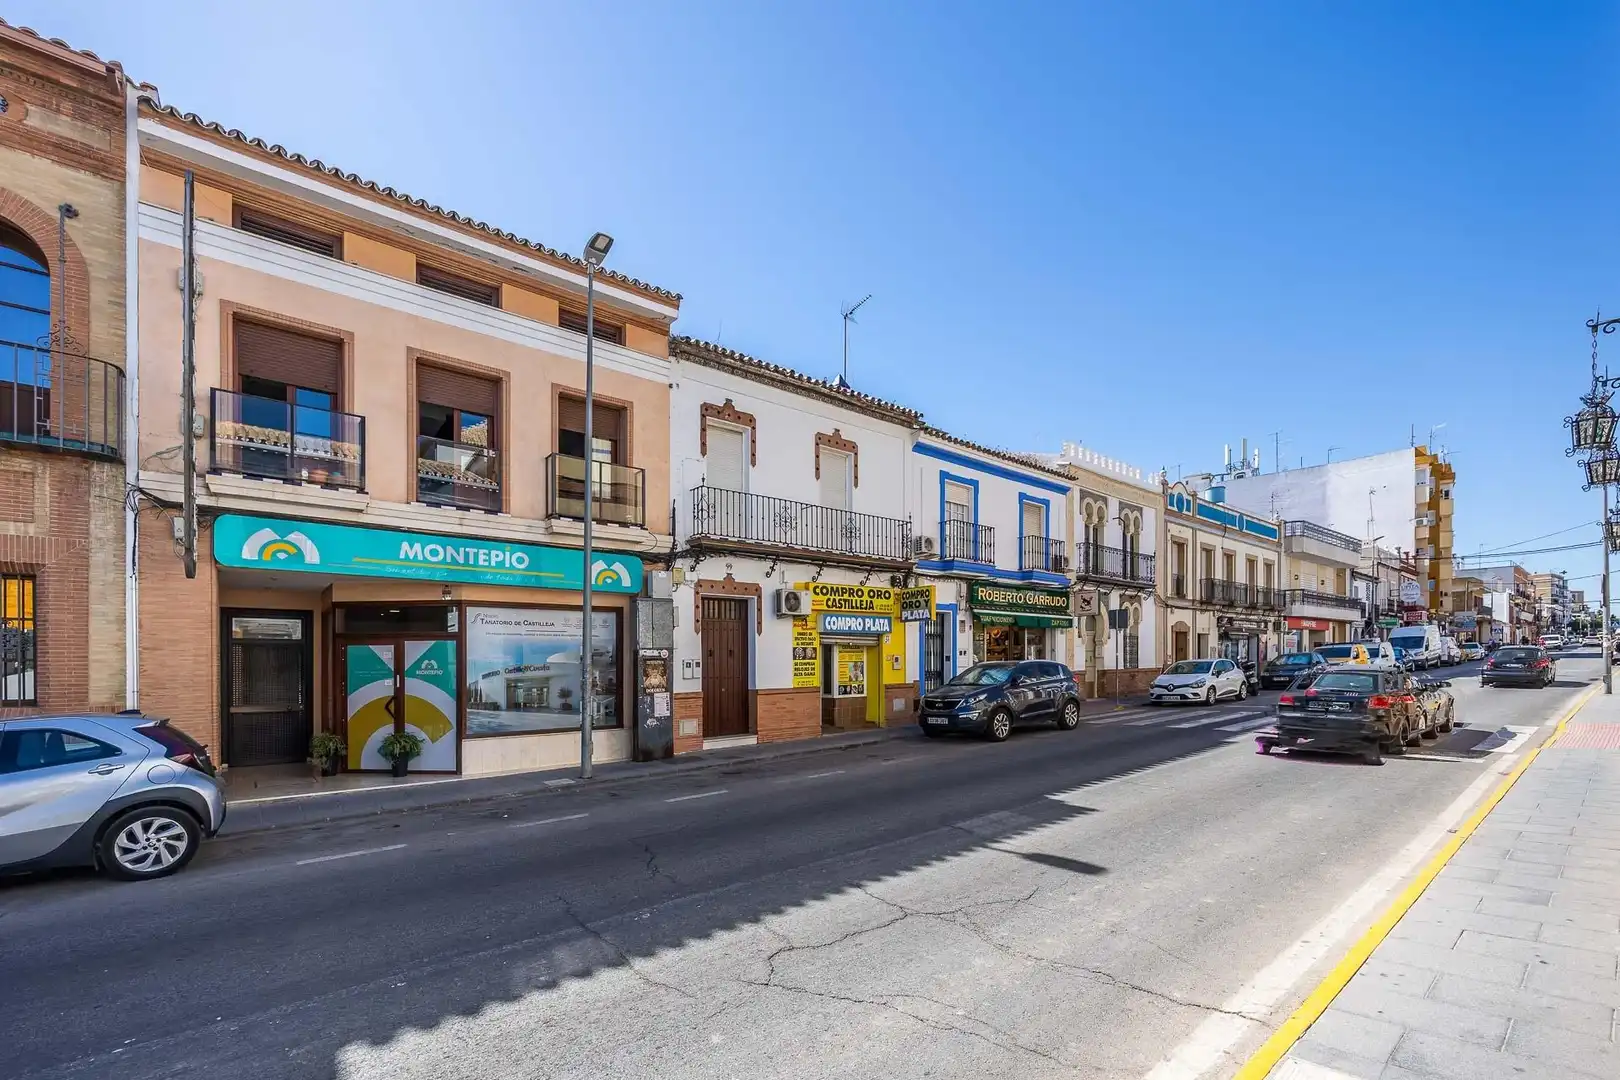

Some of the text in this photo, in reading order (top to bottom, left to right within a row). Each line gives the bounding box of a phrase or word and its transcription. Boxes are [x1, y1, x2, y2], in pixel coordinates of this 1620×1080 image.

[812, 585, 892, 600] COMPRO ORO
[901, 588, 930, 601] COMPRO
[978, 587, 1067, 607] ROBERTO GARRUDO
[825, 598, 875, 611] CASTILLEJA
[901, 599, 921, 610] ORO
[923, 598, 930, 608] Y
[901, 609, 930, 620] PLATA
[480, 618, 512, 626] TANATORIO
[825, 616, 863, 631] COMPRO
[865, 617, 890, 632] PLATA
